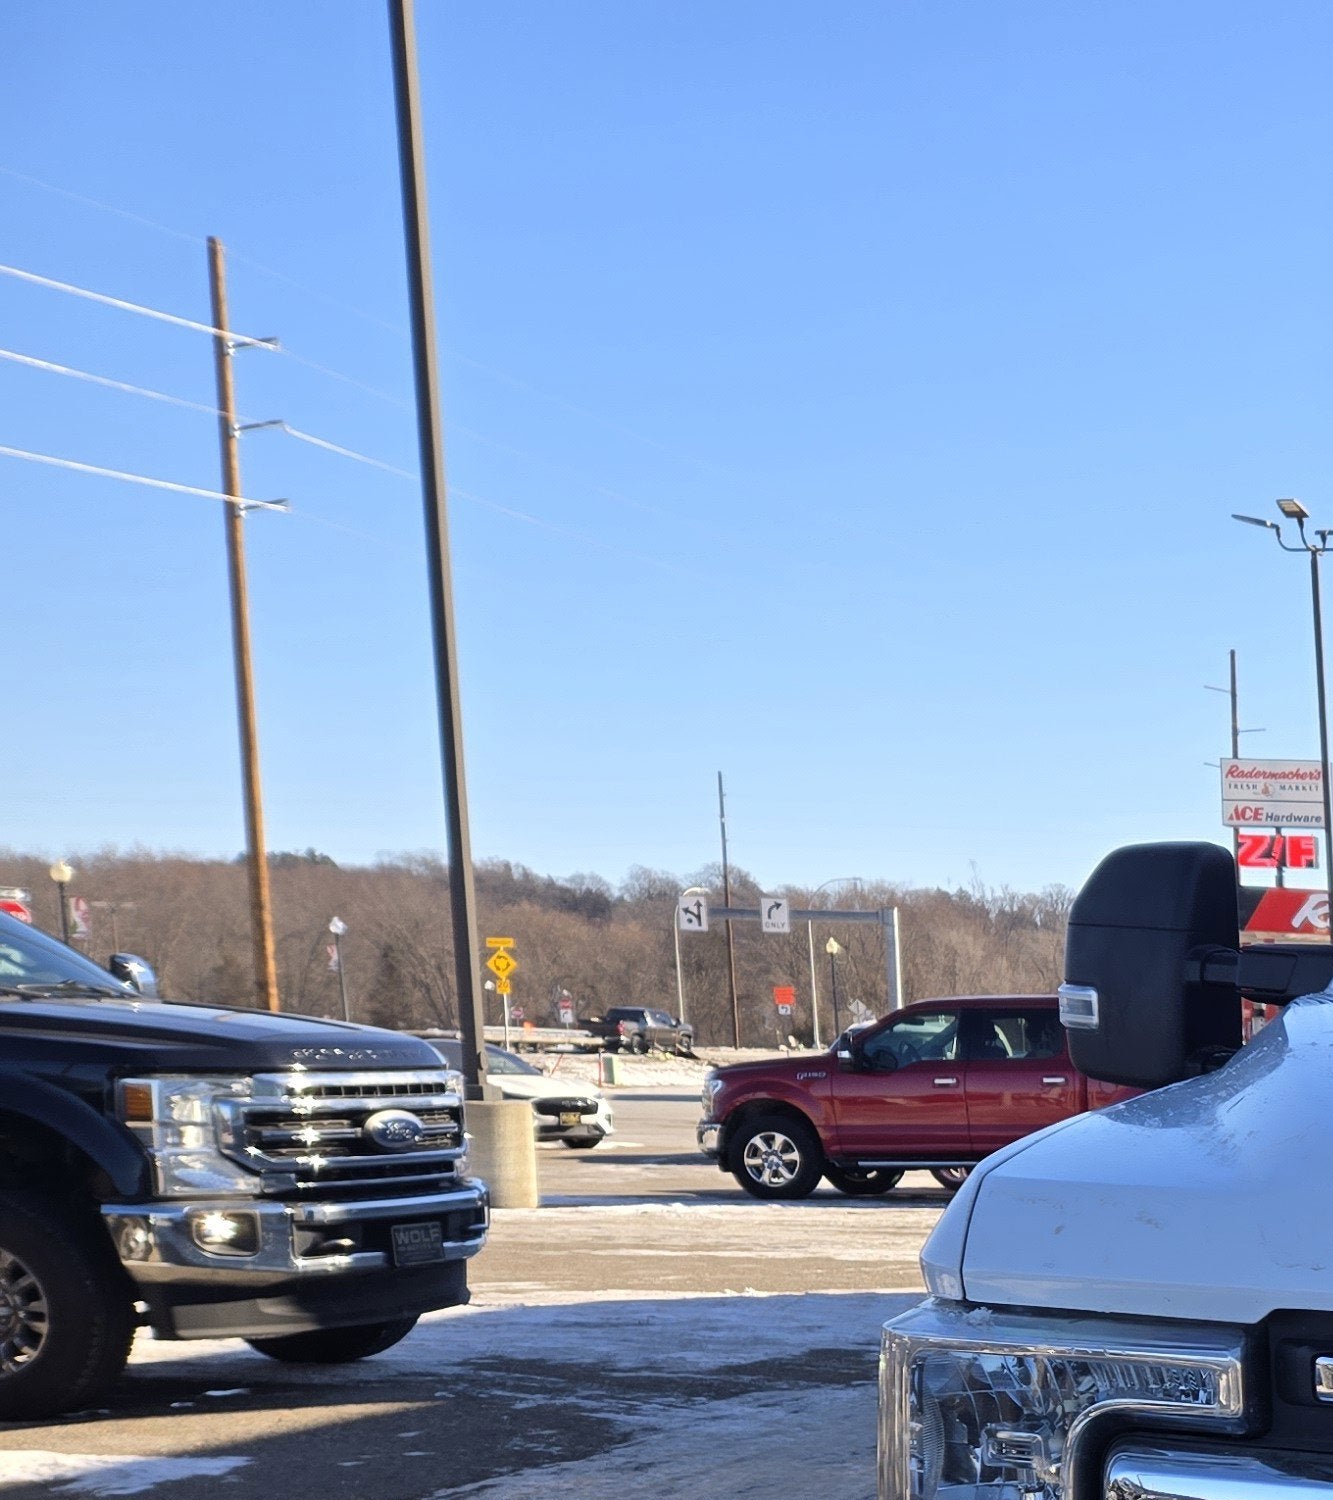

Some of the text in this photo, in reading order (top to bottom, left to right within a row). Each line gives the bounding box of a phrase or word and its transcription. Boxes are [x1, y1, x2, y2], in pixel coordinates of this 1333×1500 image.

[1225, 764, 1321, 780] Radermacher's
[1280, 784, 1319, 792] MARKET
[1228, 804, 1322, 823] ACE Hardware
[765, 921, 786, 929] ONLY
[395, 1229, 441, 1245] WOLF
